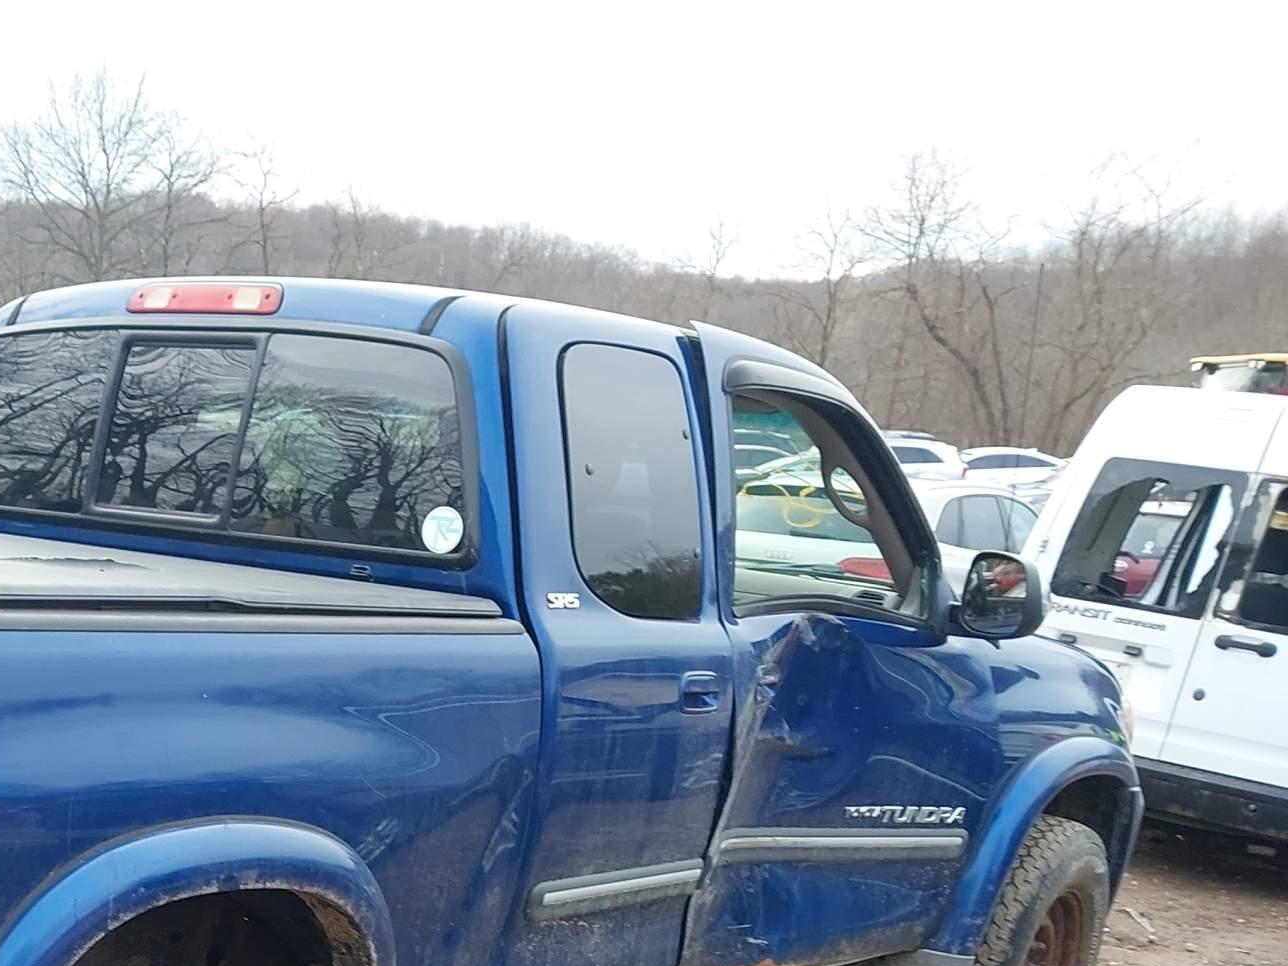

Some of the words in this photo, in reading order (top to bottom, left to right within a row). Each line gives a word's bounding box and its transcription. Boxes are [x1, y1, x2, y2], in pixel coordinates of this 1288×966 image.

[547, 592, 580, 609] SR5
[1049, 601, 1112, 621] RANSIT
[880, 805, 966, 824] TUNDRA
